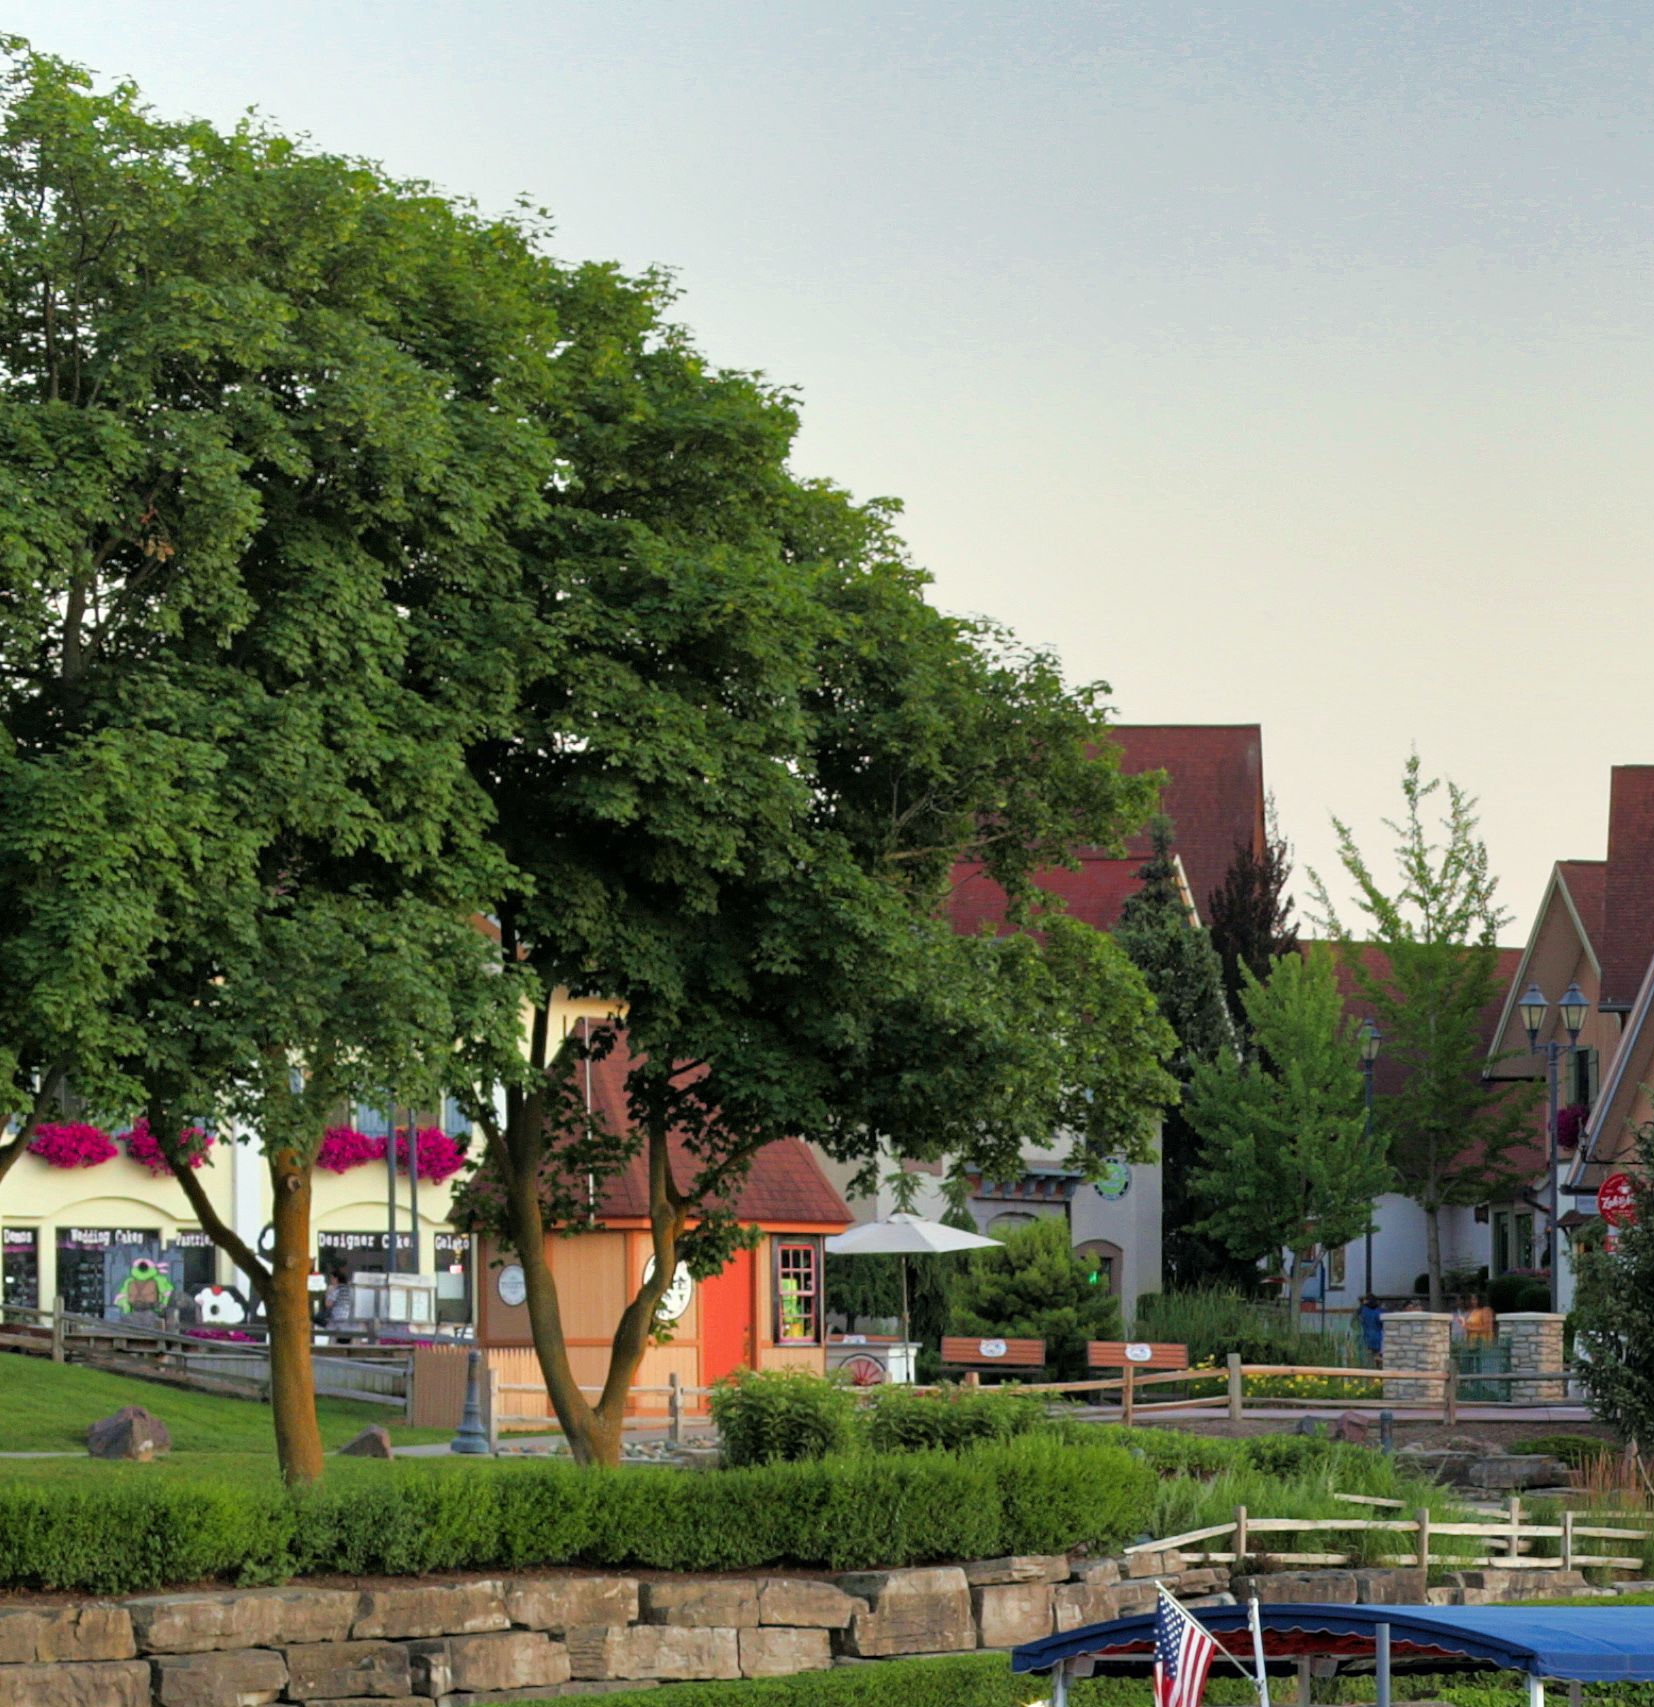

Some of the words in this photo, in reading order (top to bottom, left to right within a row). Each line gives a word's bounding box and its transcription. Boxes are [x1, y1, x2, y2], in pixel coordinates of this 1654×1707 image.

[71, 1228, 110, 1246] Wedding
[115, 1229, 144, 1245] Cakes
[318, 1232, 375, 1250] Designer
[382, 1233, 414, 1249] Cke
